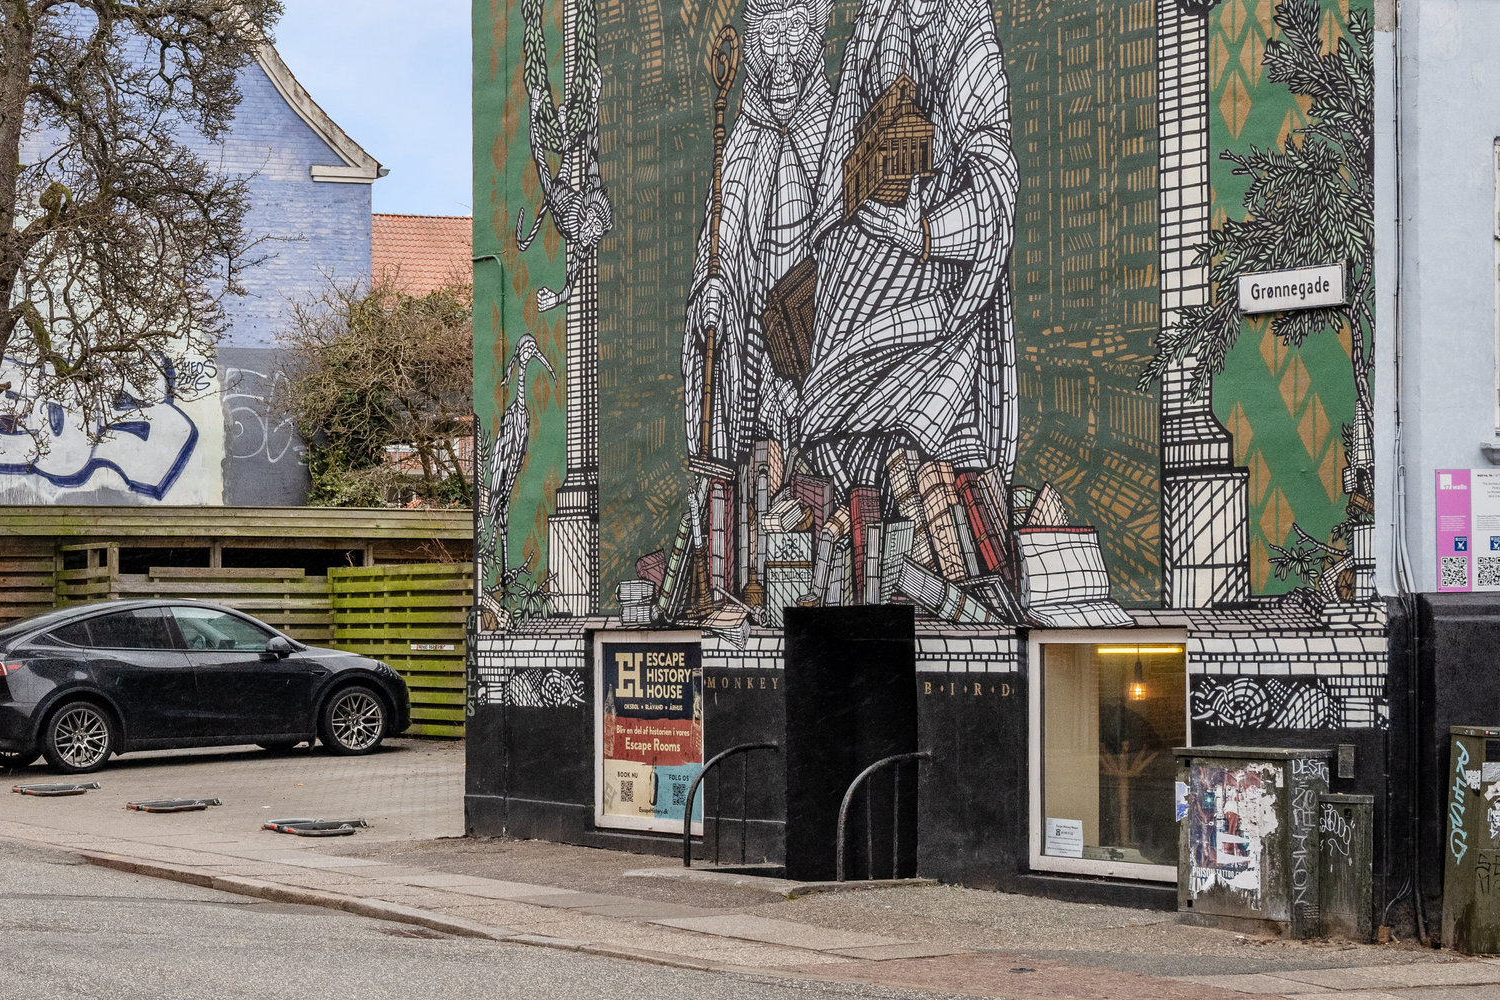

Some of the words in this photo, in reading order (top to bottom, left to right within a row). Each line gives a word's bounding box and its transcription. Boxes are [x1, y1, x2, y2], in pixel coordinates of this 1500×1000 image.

[1250, 275, 1330, 300] Grønnegade
[646, 652, 685, 667] ESCAPE
[646, 668, 691, 683] HISTORY
[707, 676, 779, 690] MONKEY
[646, 685, 683, 699] HOUSE
[645, 702, 664, 711] BLÅVAND
[669, 703, 683, 711] ÅRHUS
[616, 724, 626, 734] Bliv
[634, 726, 642, 735] del
[643, 726, 649, 735] af
[649, 726, 672, 736] historien
[676, 729, 690, 737] vores
[625, 737, 652, 756] Escape
[653, 738, 681, 752] Rooms
